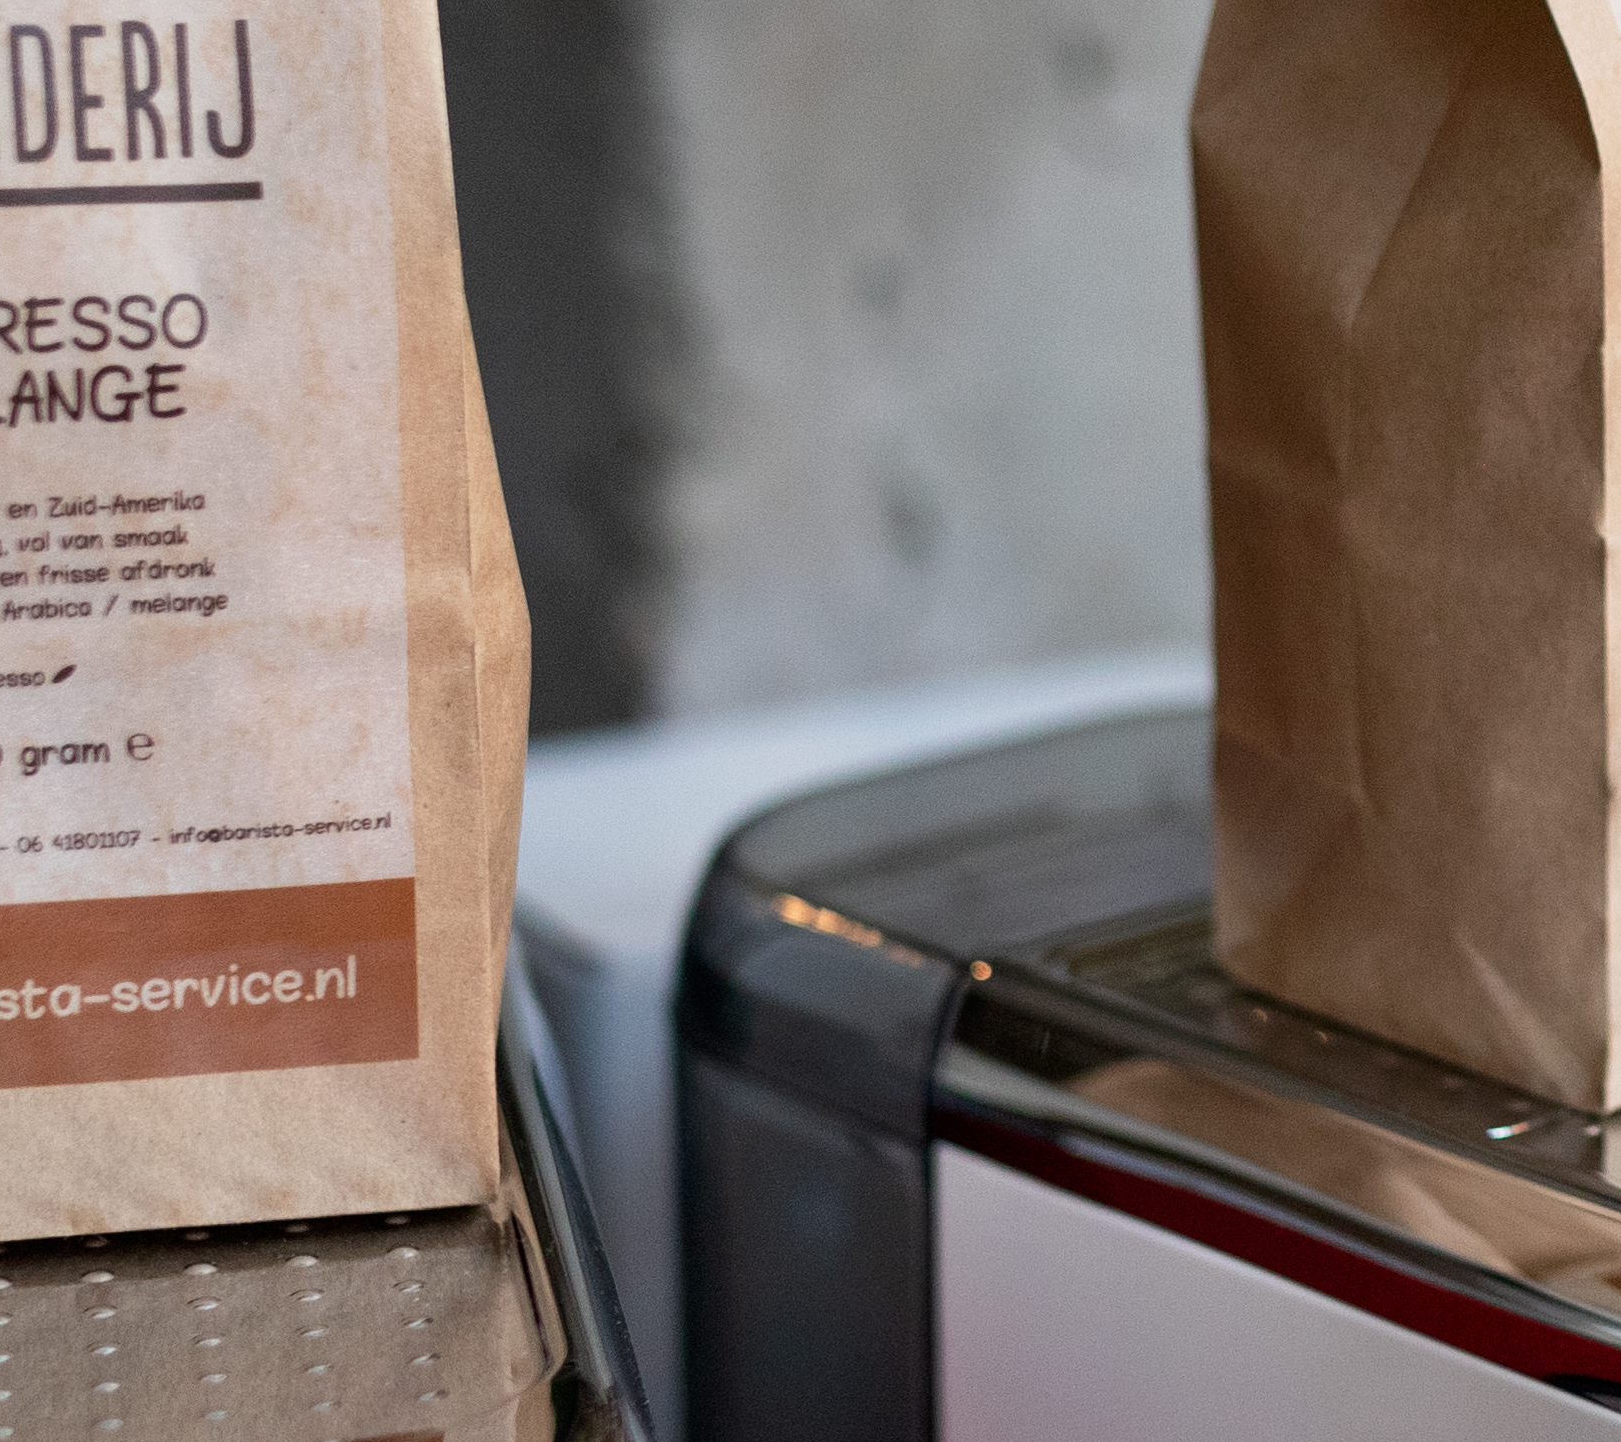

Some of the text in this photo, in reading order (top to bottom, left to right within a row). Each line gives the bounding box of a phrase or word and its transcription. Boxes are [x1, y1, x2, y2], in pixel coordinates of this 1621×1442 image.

[8, 503, 38, 520] en
[47, 490, 206, 519] Zuid-Amerika
[18, 531, 51, 552] vol
[61, 532, 104, 551] van
[114, 524, 189, 549] smaak
[37, 563, 111, 586] frisse
[121, 556, 217, 581] afdronk
[2, 598, 93, 622] Arabica
[129, 592, 229, 617] melange
[19, 741, 112, 777] gram
[16, 835, 45, 855] 06
